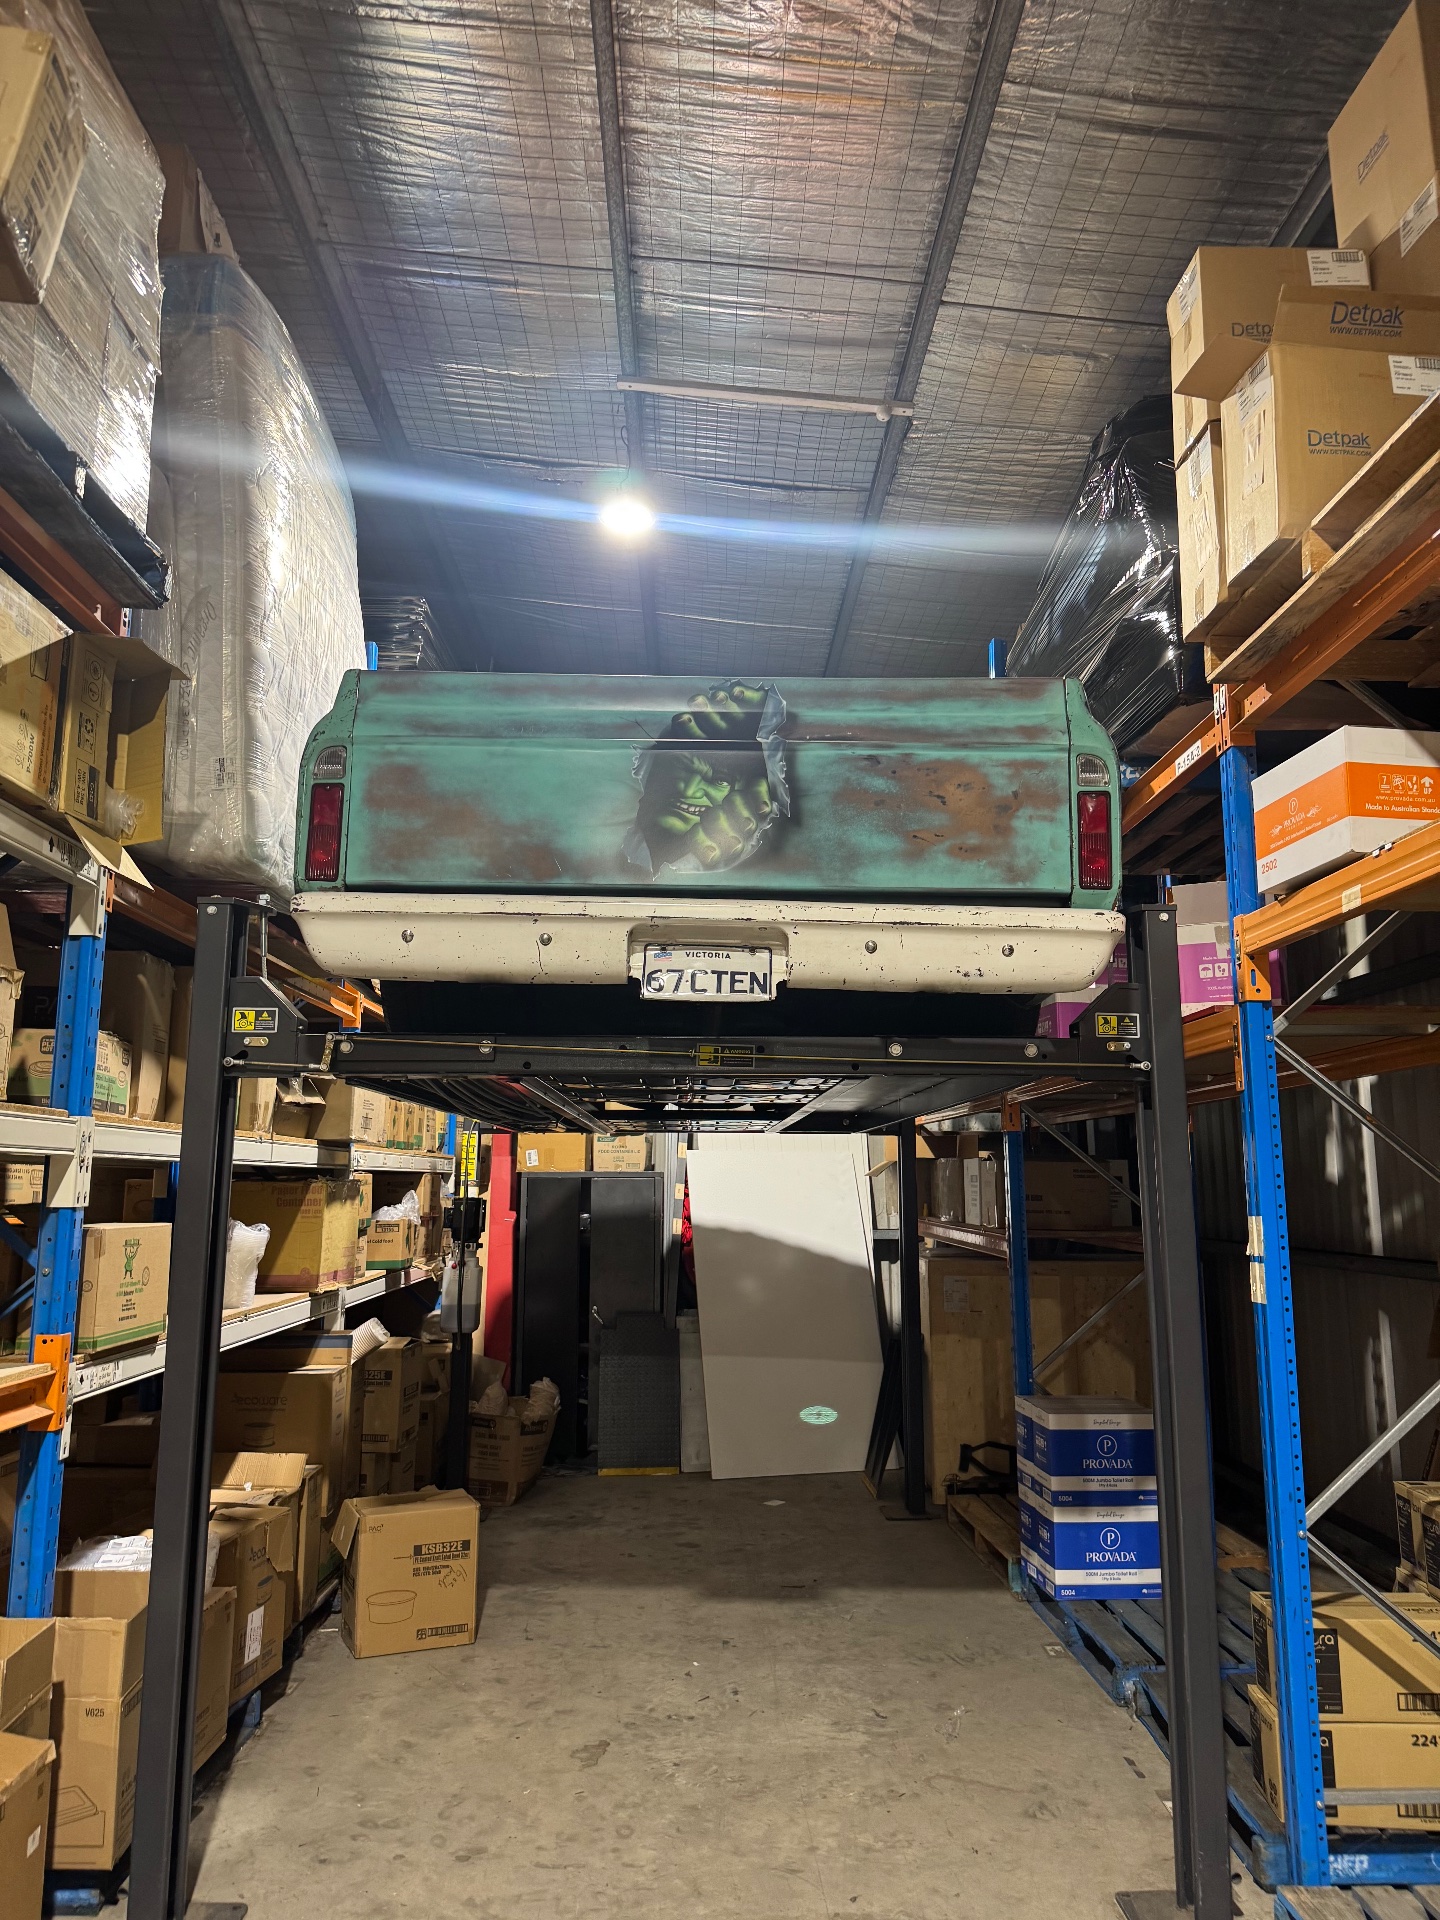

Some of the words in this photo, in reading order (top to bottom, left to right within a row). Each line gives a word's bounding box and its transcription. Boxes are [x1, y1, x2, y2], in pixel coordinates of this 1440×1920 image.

[1357, 129, 1389, 180] Detpak
[1331, 301, 1404, 326] Detpak
[1231, 321, 1274, 337] Detp
[1329, 326, 1402, 338] WWW.DETPAK.COM
[1307, 429, 1371, 448] Detpak
[1308, 448, 1372, 457] WWW.DETPAK.COM
[1423, 787, 1433, 795] UP
[1365, 802, 1382, 811] Made
[1391, 804, 1420, 813] Australian
[1261, 858, 1278, 875] 2502
[685, 951, 732, 960] VICTORIA
[646, 968, 768, 994] 67CTEN
[271, 1185, 298, 1197] Paper
[276, 1197, 323, 1207] Container
[238, 1395, 288, 1406] ecoware
[1083, 1459, 1133, 1469] PROVADA
[421, 1540, 463, 1555] KSB32E
[1086, 1552, 1136, 1562] PROVADA
[1410, 1733, 1440, 1748] 224
